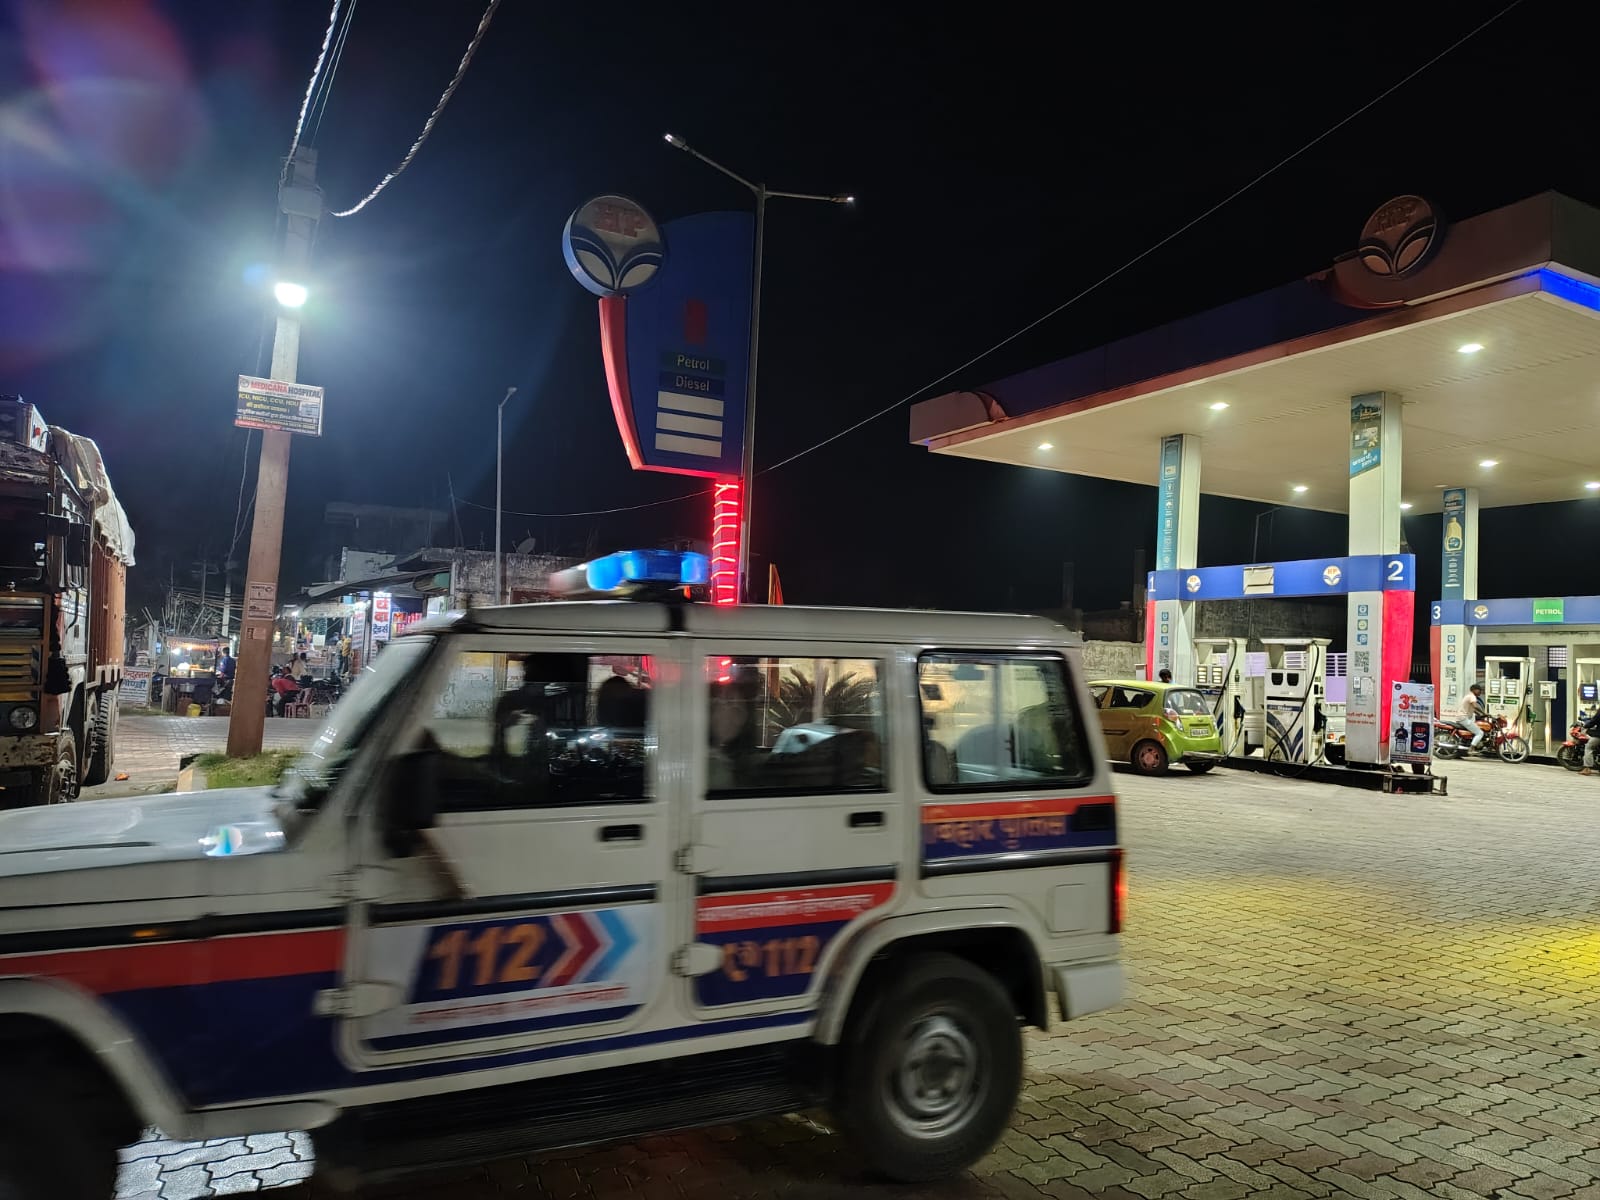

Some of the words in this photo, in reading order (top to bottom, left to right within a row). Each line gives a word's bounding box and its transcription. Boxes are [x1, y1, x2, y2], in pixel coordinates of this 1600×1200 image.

[677, 354, 710, 370] Petrol
[250, 381, 288, 393] MEDICANA
[288, 388, 321, 398] HOSPITAL
[675, 375, 710, 392] Diesel
[1387, 560, 1404, 581] 2
[1148, 576, 1156, 592] 1
[1432, 605, 1441, 620] 3
[1398, 693, 1418, 711] 3%
[428, 923, 547, 990] 112
[763, 935, 819, 977] 112
